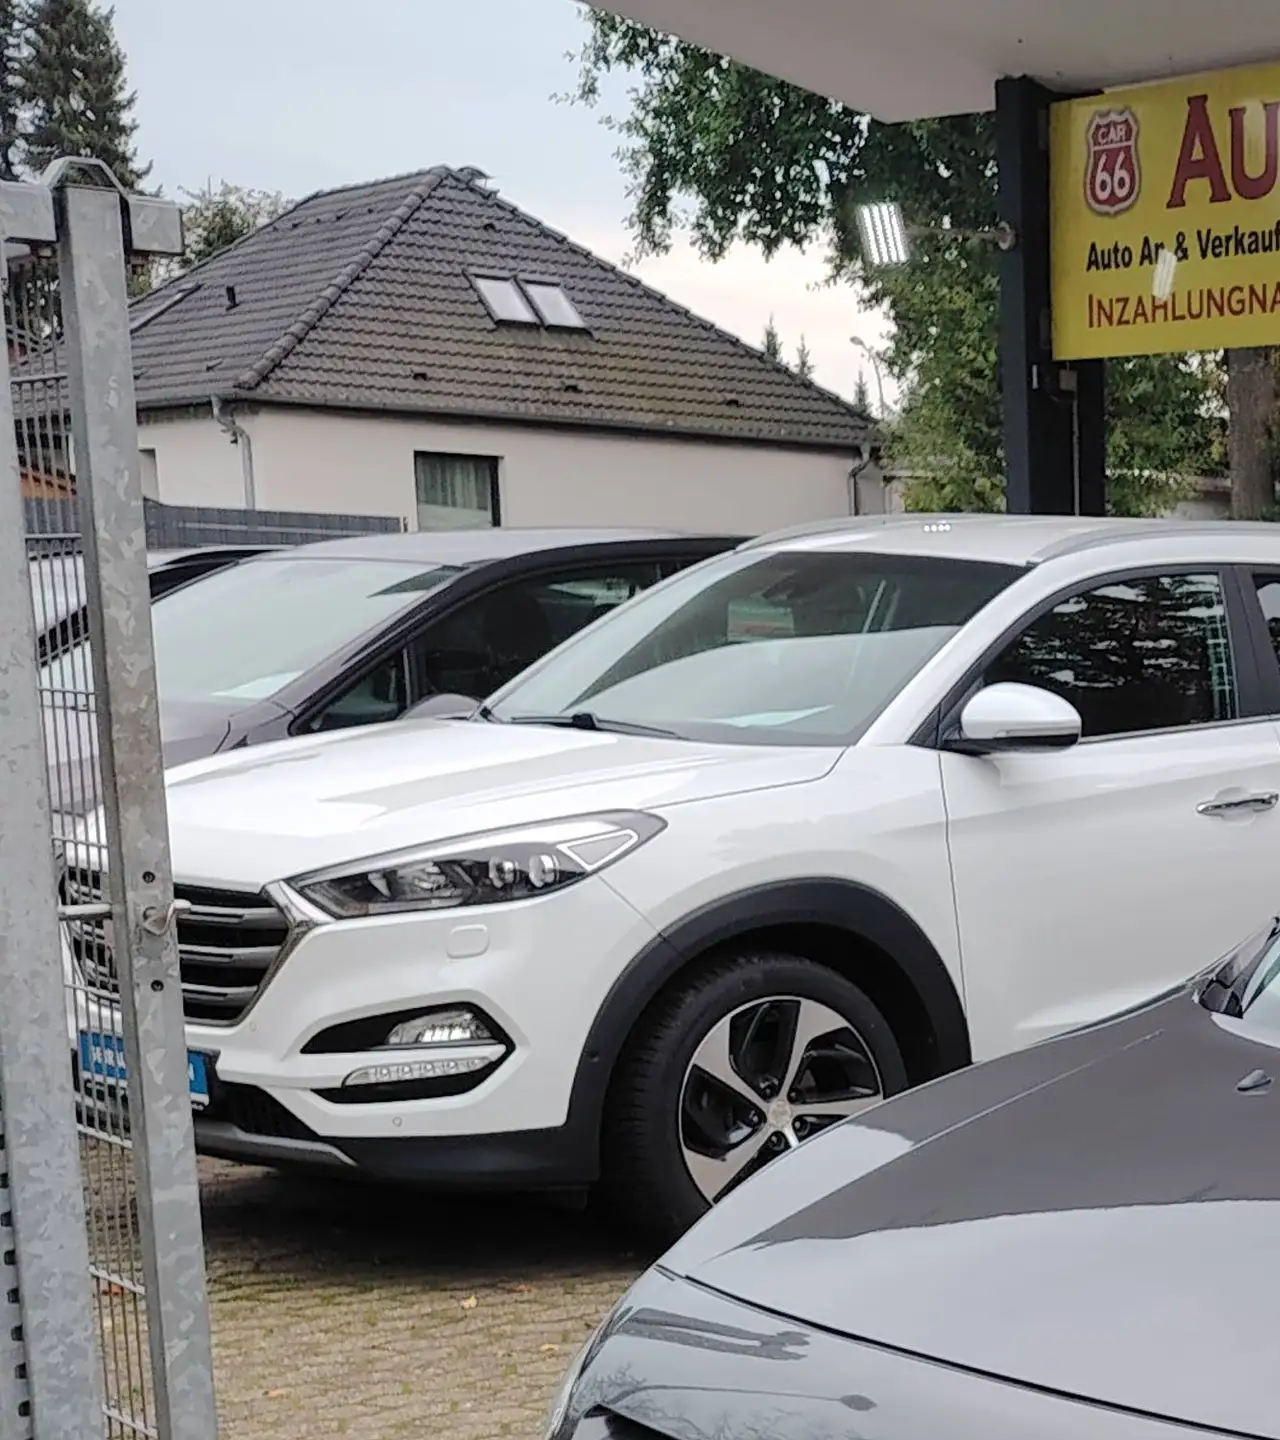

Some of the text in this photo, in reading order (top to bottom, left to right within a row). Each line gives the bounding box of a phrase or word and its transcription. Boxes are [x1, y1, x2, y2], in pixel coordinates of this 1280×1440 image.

[1098, 123, 1127, 145] CAR
[1095, 150, 1131, 200] 66
[1086, 240, 1132, 272] Auto
[1174, 230, 1189, 262] &
